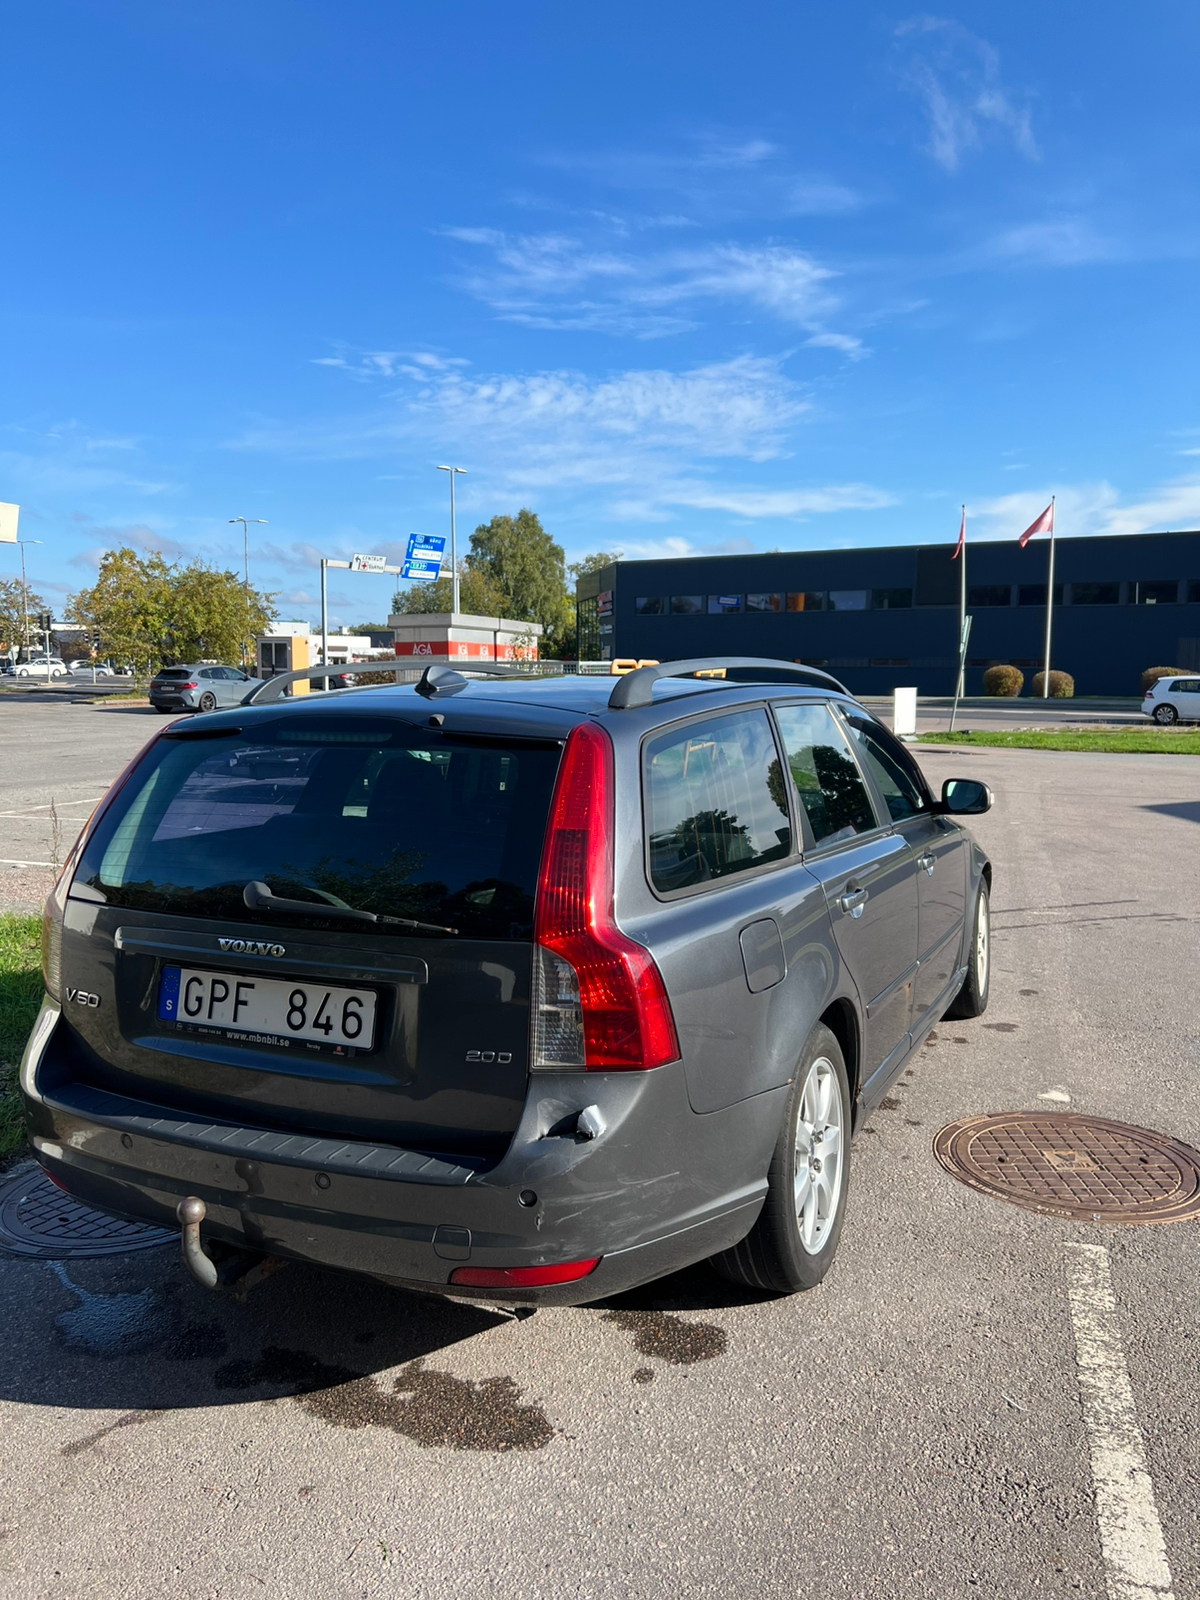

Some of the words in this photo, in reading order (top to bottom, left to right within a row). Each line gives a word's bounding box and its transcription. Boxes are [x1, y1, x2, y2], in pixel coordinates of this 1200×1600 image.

[362, 555, 383, 563] CENTRUM
[412, 643, 433, 656] AGA
[217, 938, 286, 957] VOLVO
[65, 987, 100, 1008] V50
[165, 999, 173, 1011] S
[183, 976, 255, 1023] GPF
[286, 988, 364, 1039] 846
[226, 1031, 290, 1047] www.mbnbil.se
